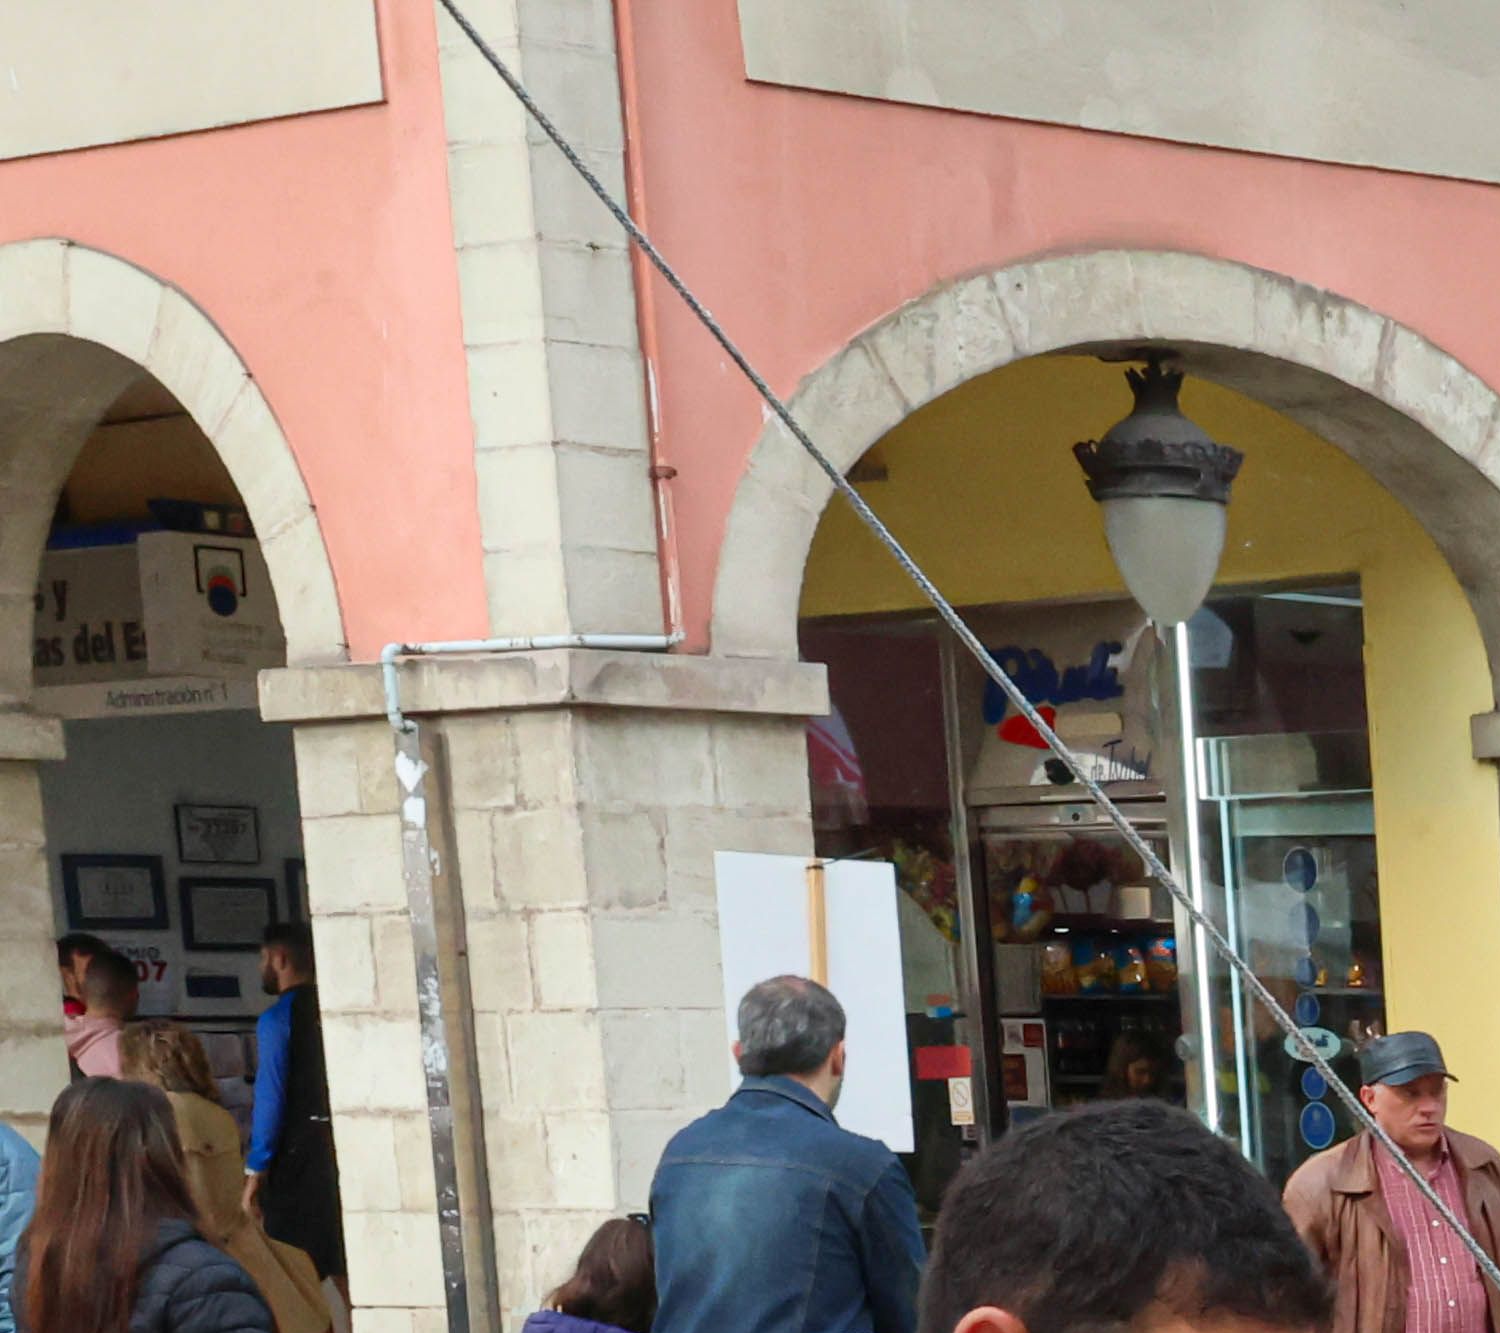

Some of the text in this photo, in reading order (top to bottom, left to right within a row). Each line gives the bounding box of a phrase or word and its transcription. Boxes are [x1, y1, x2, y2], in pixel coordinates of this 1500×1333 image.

[35, 636, 66, 667] as
[73, 621, 116, 664] del
[136, 960, 168, 982] 07
